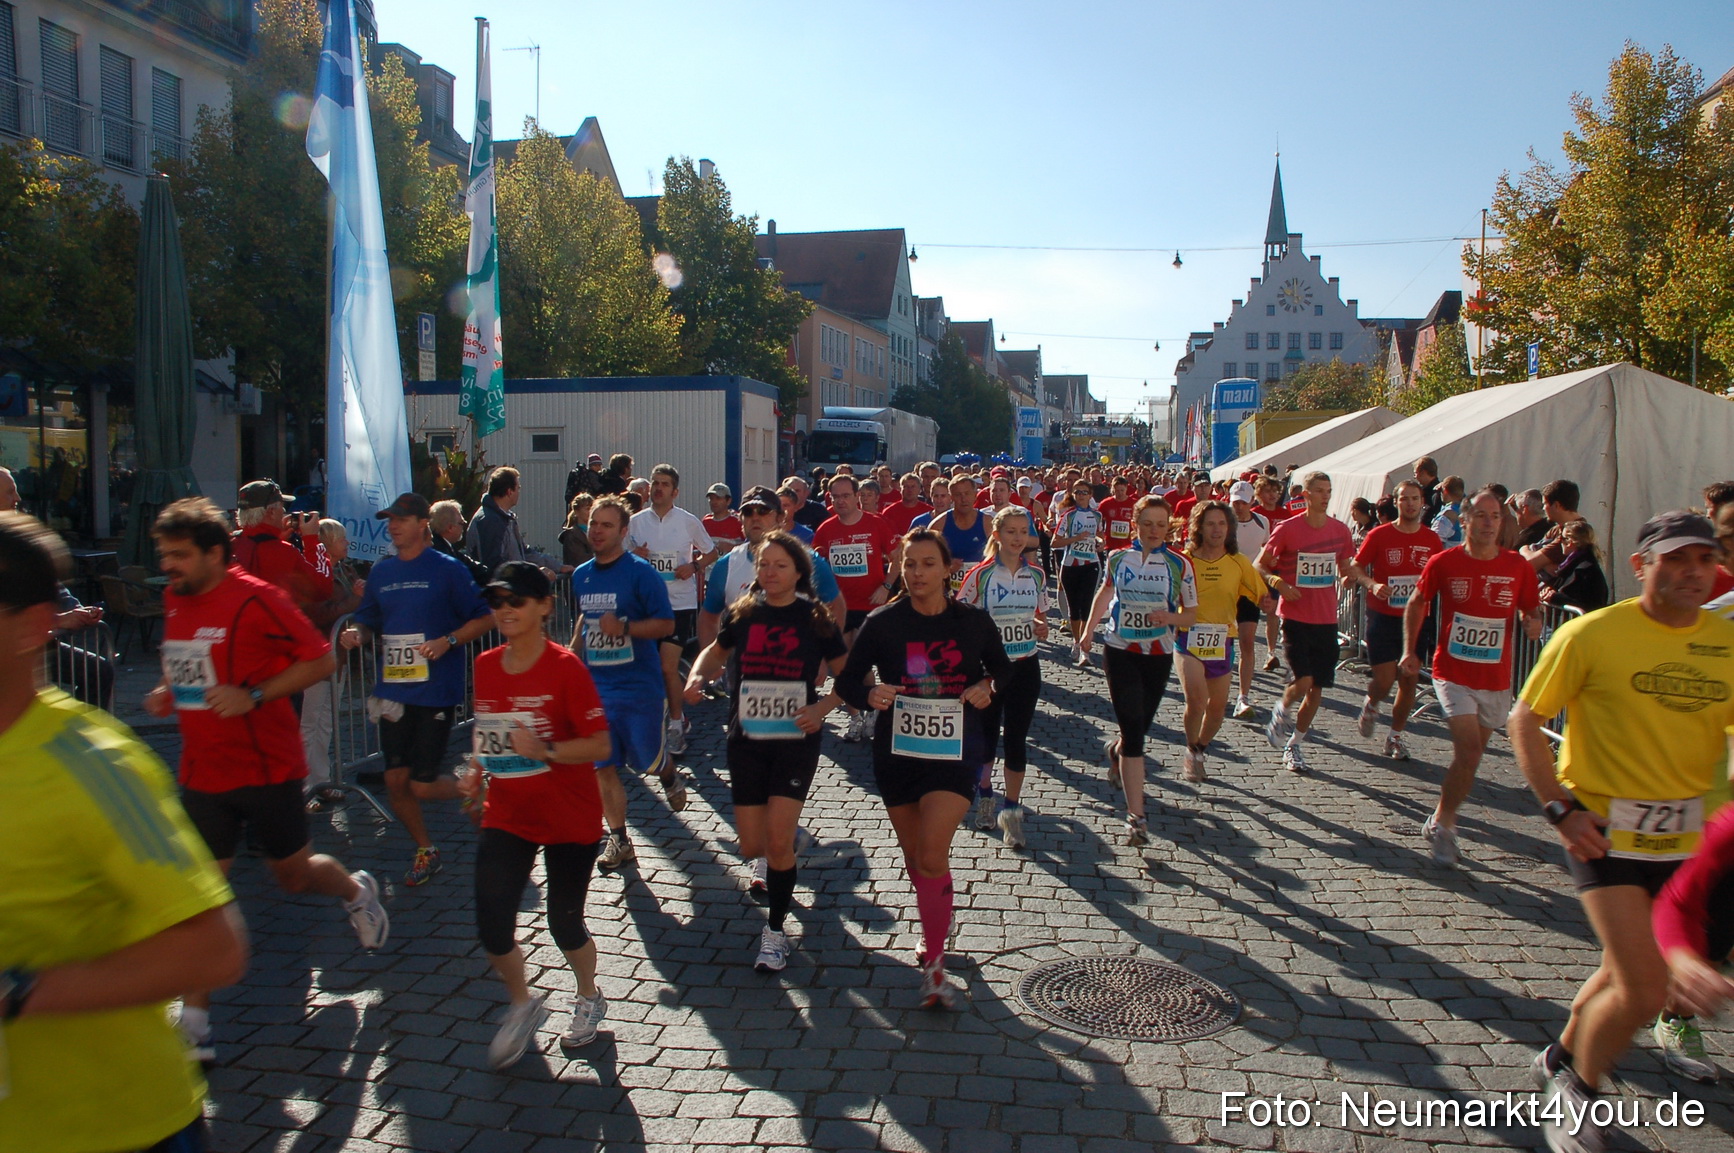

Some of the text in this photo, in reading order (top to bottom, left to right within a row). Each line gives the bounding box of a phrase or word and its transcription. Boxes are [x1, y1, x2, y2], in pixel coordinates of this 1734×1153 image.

[1222, 386, 1255, 404] maxi
[1073, 541, 1094, 552] 2274
[833, 552, 863, 566] 2823
[1301, 562, 1333, 575] 3114
[1138, 574, 1165, 582] PLAST
[580, 593, 617, 604] HUBER
[1011, 588, 1035, 596] PLAST
[1134, 629, 1152, 637] Rita
[1456, 626, 1499, 647] 3020
[1196, 633, 1220, 647] 578
[387, 647, 415, 665] 579
[1198, 648, 1216, 656] Frank
[1461, 645, 1489, 657] Bernd
[746, 696, 799, 718] 3556
[900, 712, 955, 738] 3555
[1633, 802, 1685, 833] 721
